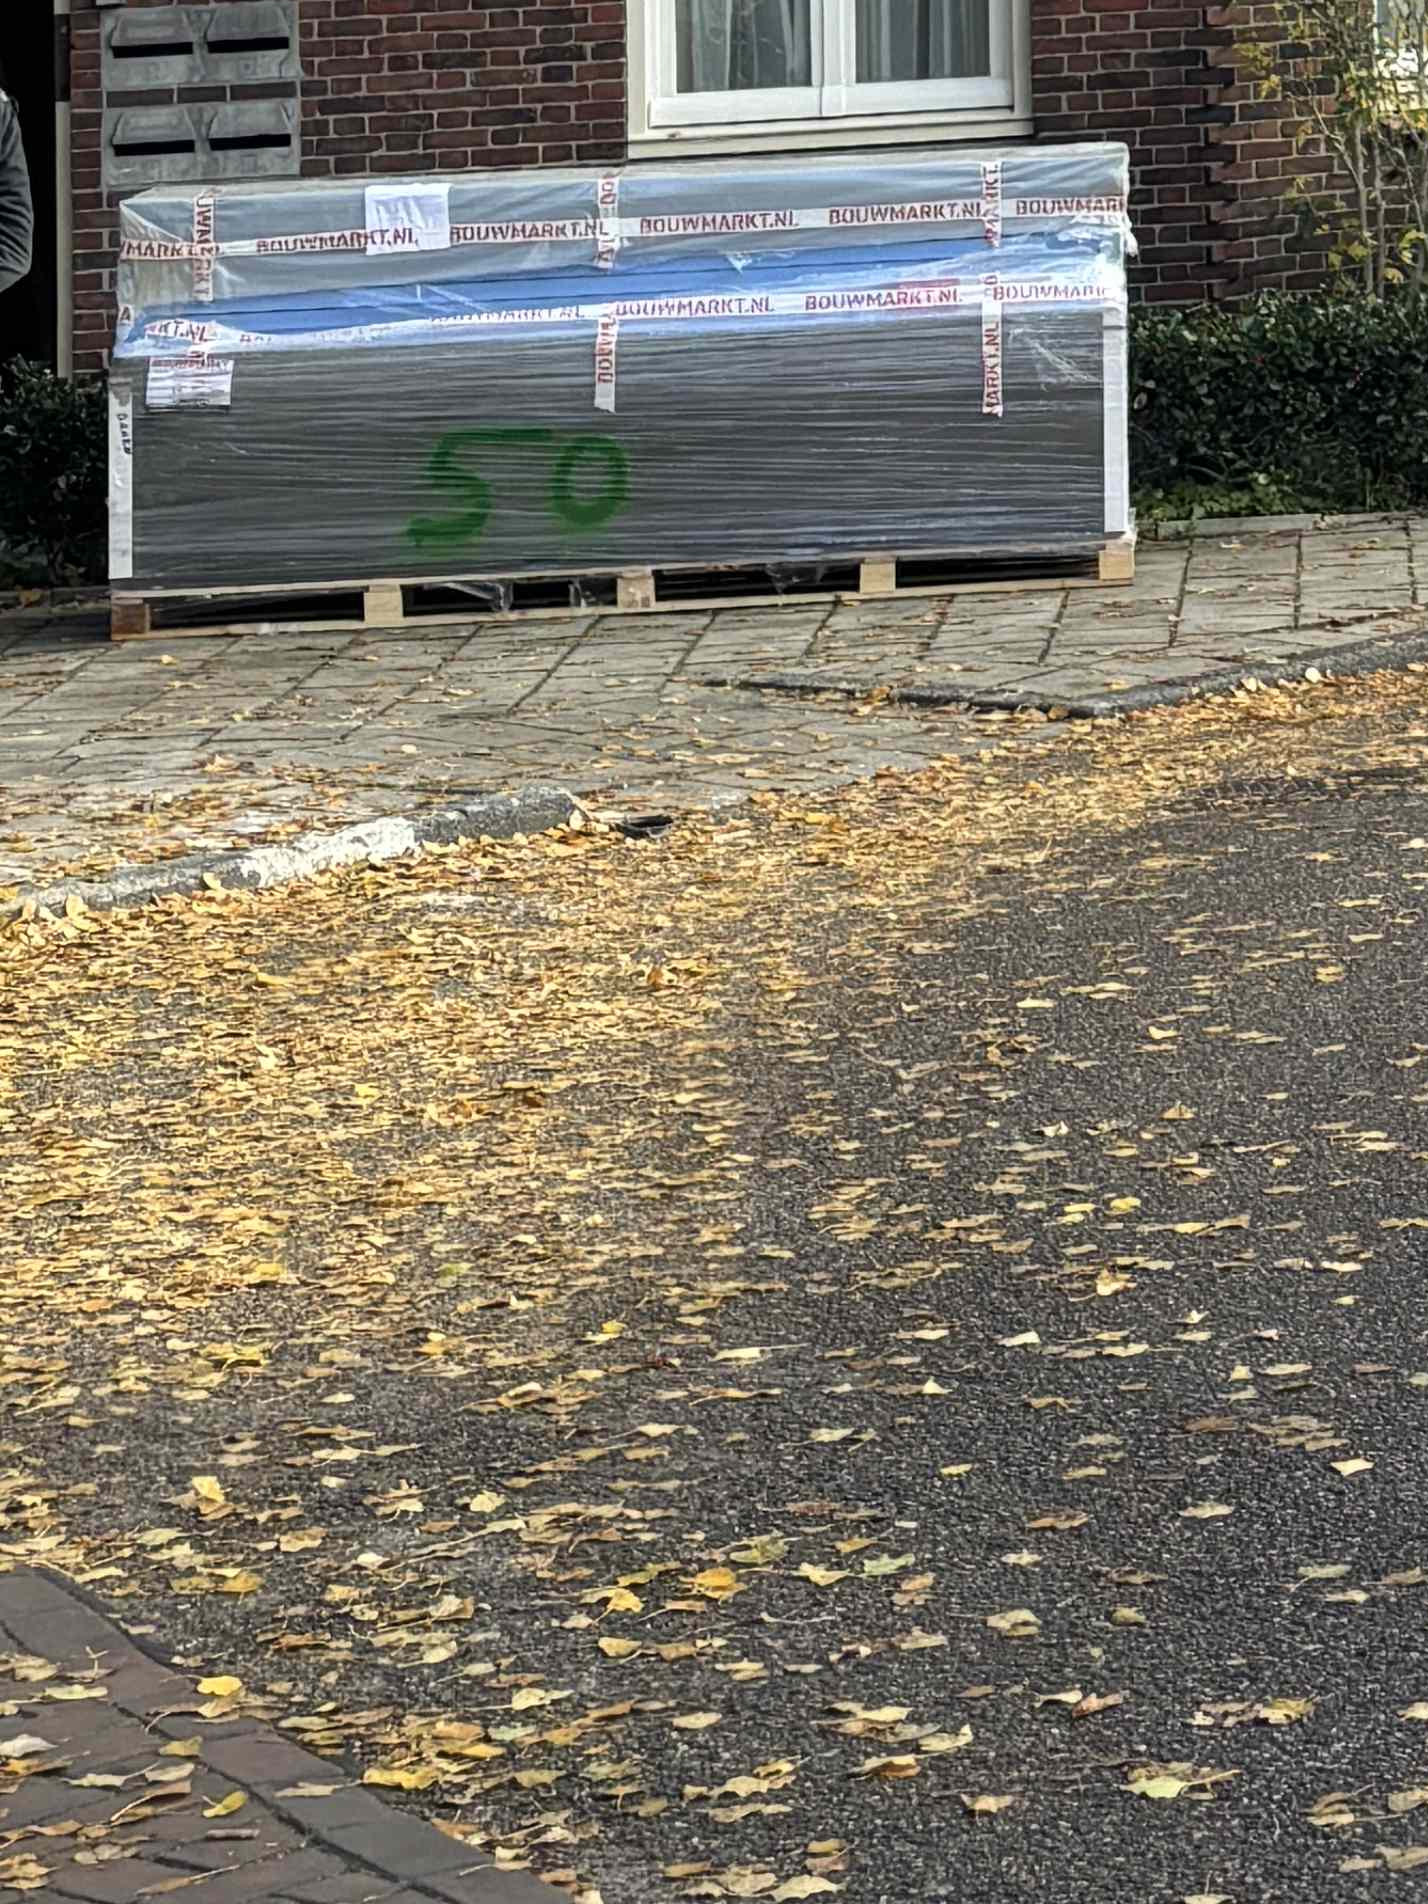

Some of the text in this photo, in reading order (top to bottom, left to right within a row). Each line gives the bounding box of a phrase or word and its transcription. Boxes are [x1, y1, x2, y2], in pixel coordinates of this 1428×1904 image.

[256, 228, 418, 253] BOUWMARKT.NL
[640, 208, 798, 234] BOUWMARKT.NL
[805, 289, 962, 311] BOUWMARKT.NL
[406, 427, 630, 538] 50
